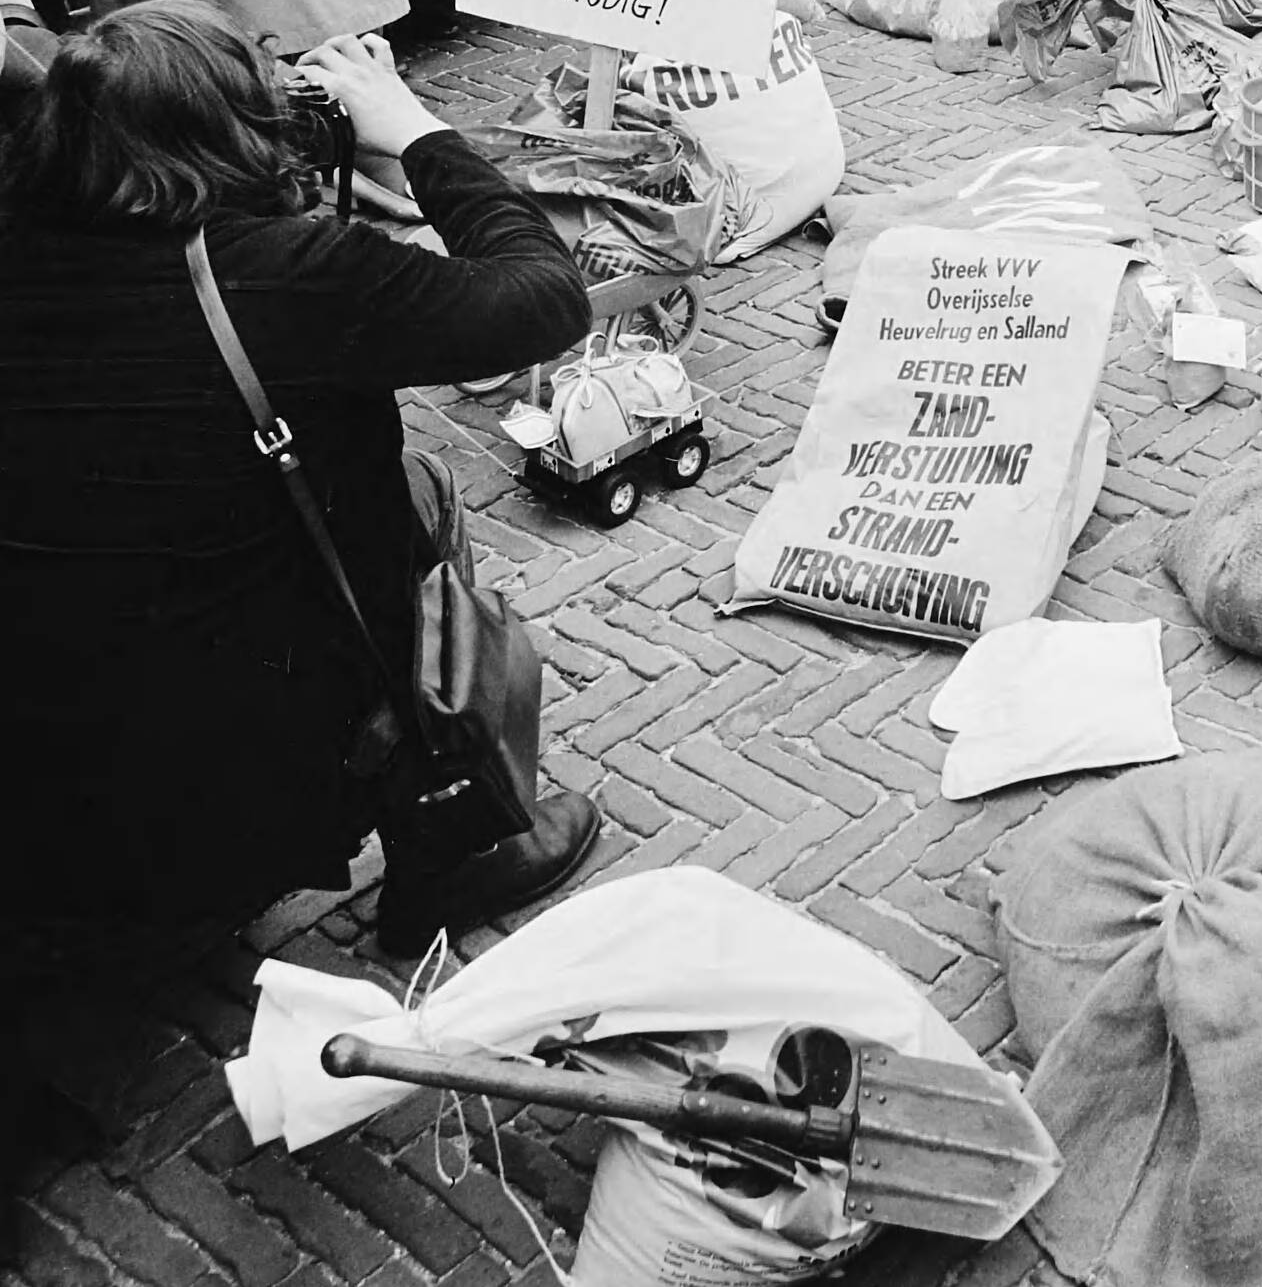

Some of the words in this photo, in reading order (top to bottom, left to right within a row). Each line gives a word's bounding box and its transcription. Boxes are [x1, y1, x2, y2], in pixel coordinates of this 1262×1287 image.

[930, 256, 988, 280] Streek
[996, 259, 1042, 280] VVV
[926, 286, 1034, 314] Overijsselse
[879, 318, 972, 344] Heuvelrug
[976, 323, 998, 341] en
[1003, 316, 1070, 341] Salland
[897, 360, 974, 387] BETER
[981, 363, 1027, 388] EEN
[908, 391, 995, 438] ZAND-
[841, 440, 1033, 486] VERSTUIVING
[859, 481, 923, 510] DAN
[925, 490, 976, 512] EEN
[828, 506, 960, 557] STRAND-
[769, 546, 992, 633] VERSCHUIVING
